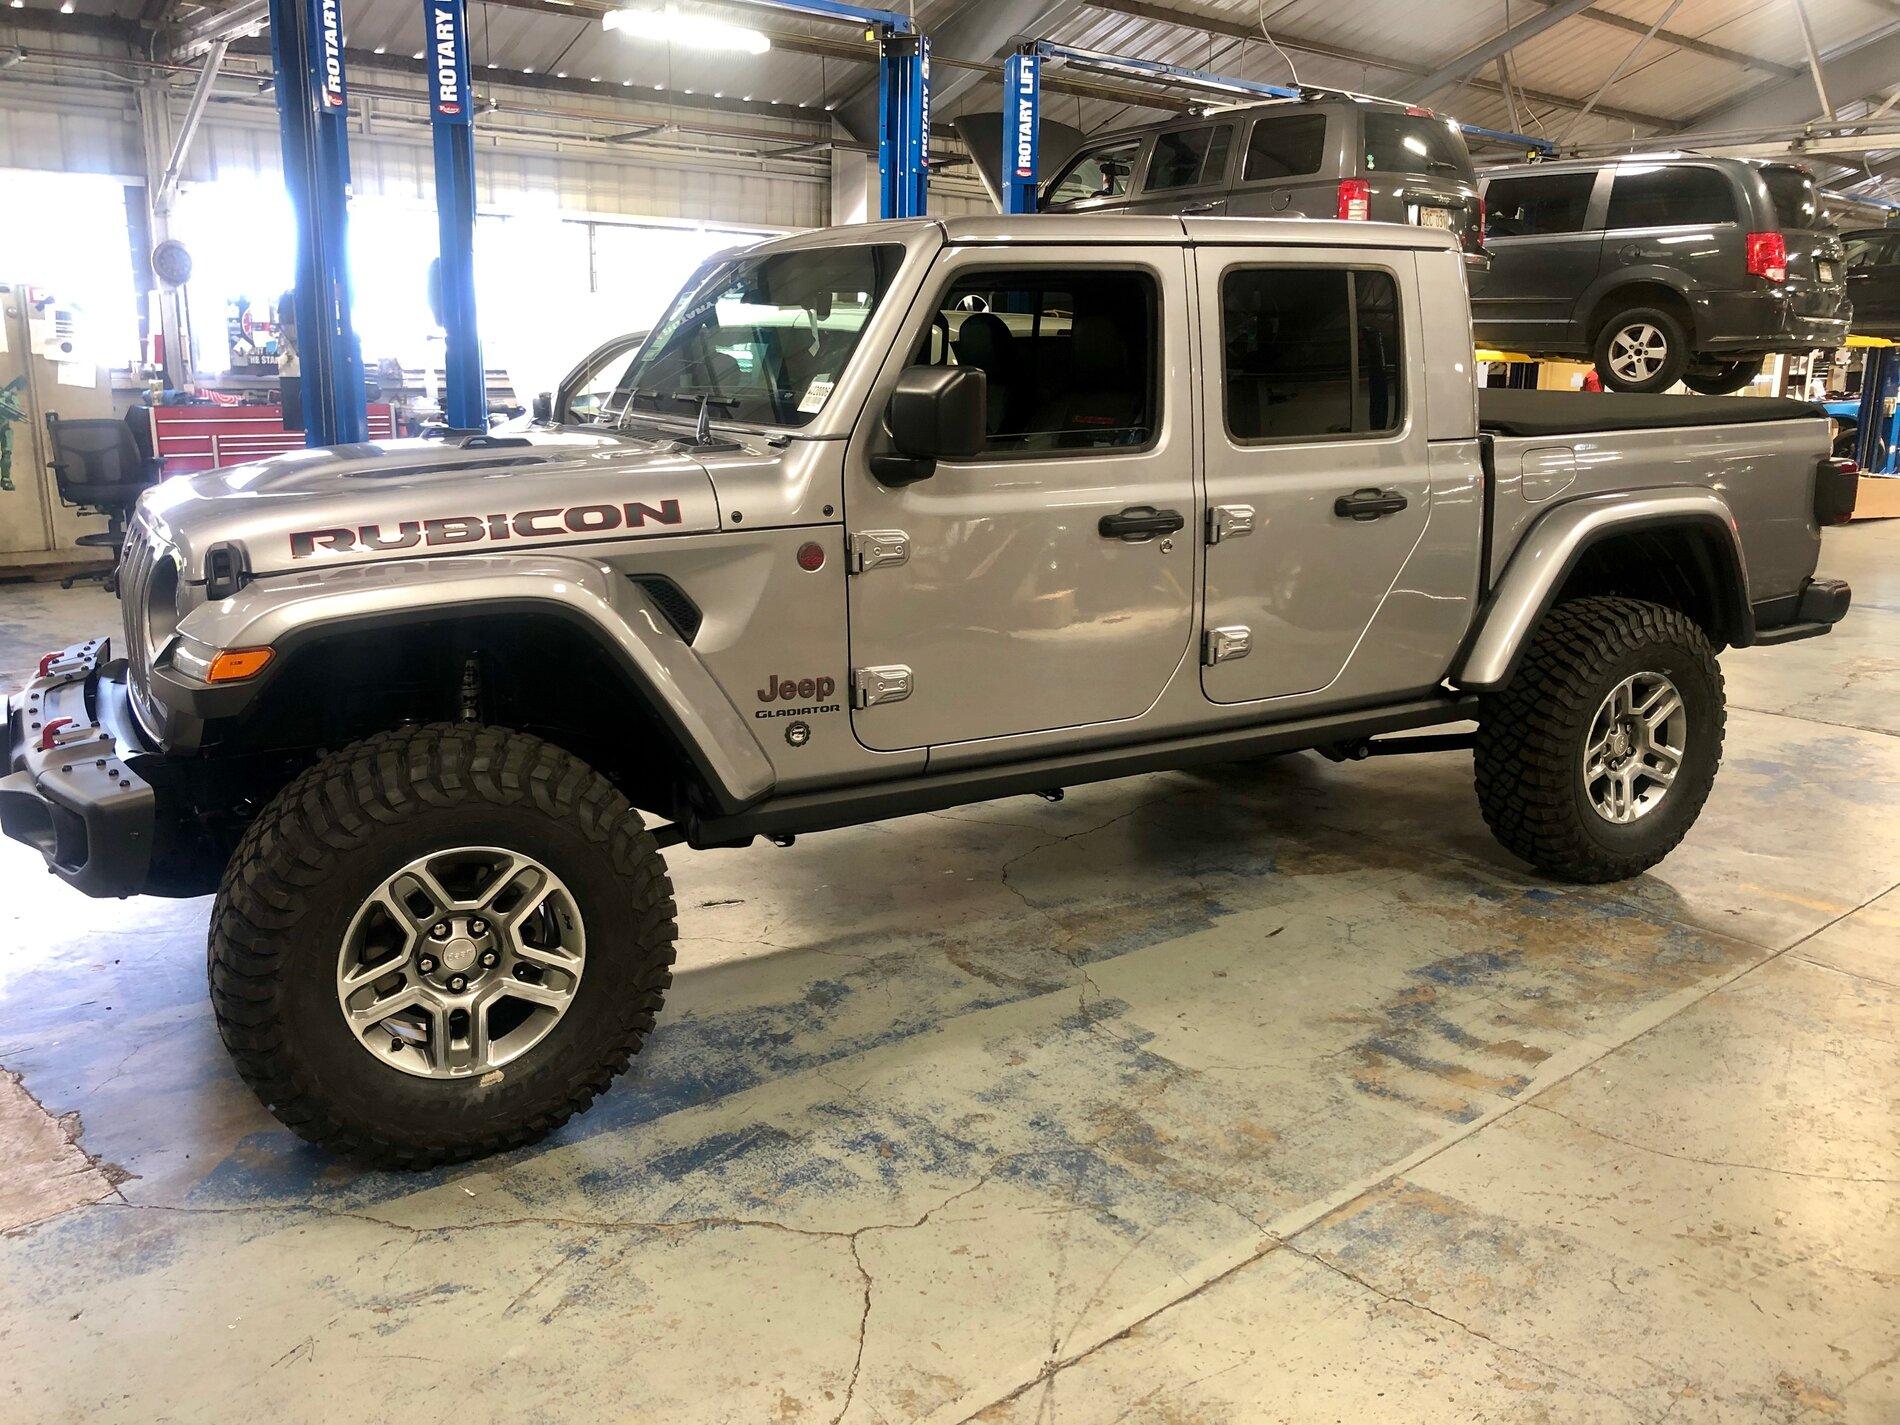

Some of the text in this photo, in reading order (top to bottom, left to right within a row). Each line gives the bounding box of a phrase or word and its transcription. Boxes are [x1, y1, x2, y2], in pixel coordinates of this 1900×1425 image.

[435, 8, 458, 102] ROTARY
[1020, 57, 1034, 94] LIFT
[921, 84, 929, 158] ROTARY
[1018, 98, 1033, 168] ROTARY
[289, 499, 683, 560] RUBICON
[754, 704, 841, 719] GLADIATOR
[757, 674, 836, 703] Jeep
